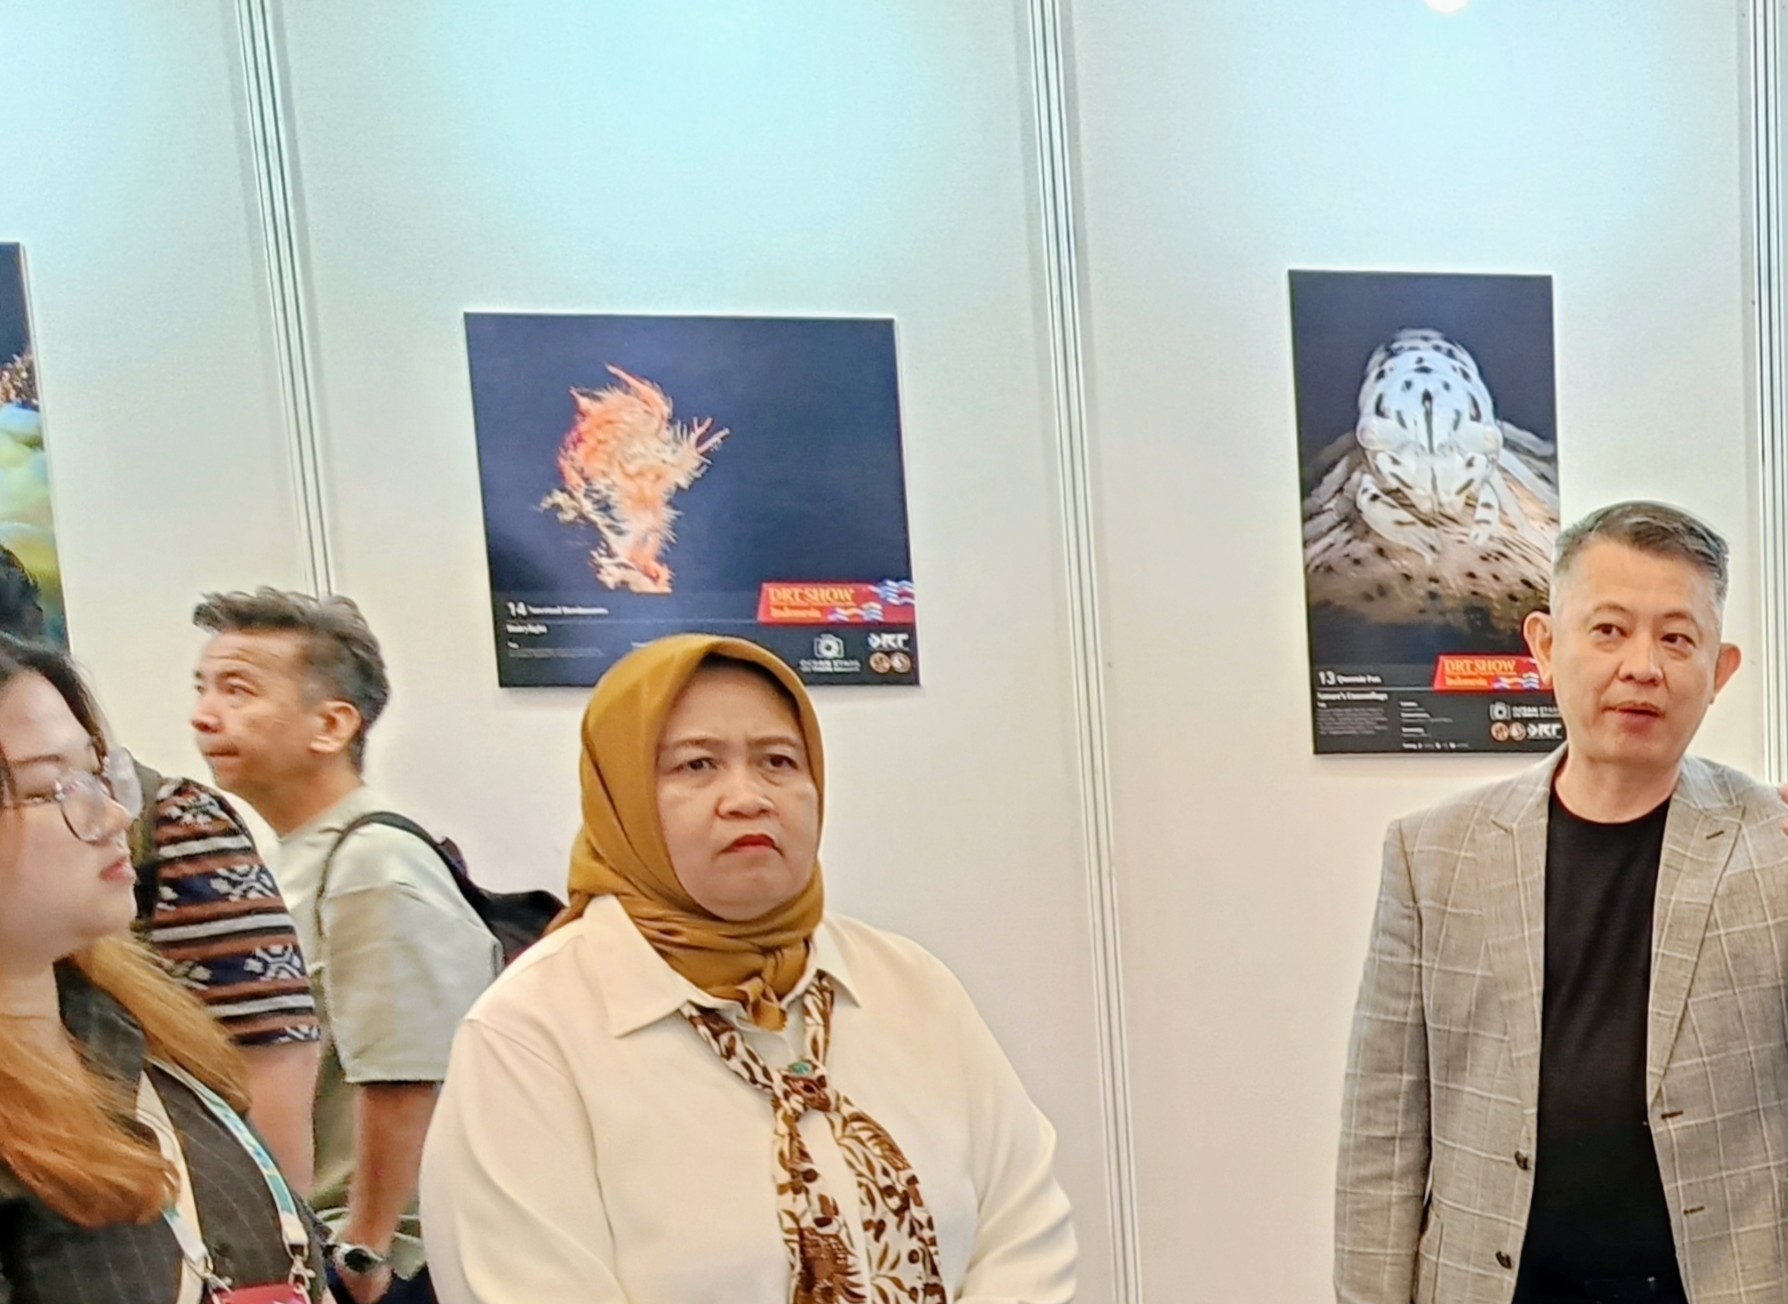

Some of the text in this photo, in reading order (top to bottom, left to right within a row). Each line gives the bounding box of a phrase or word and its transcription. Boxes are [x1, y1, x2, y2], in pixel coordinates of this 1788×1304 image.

[804, 587, 854, 601] SHOW
[507, 601, 527, 616] 14
[1444, 659, 1516, 673] DRT SHOW
[1319, 671, 1335, 685] 13
